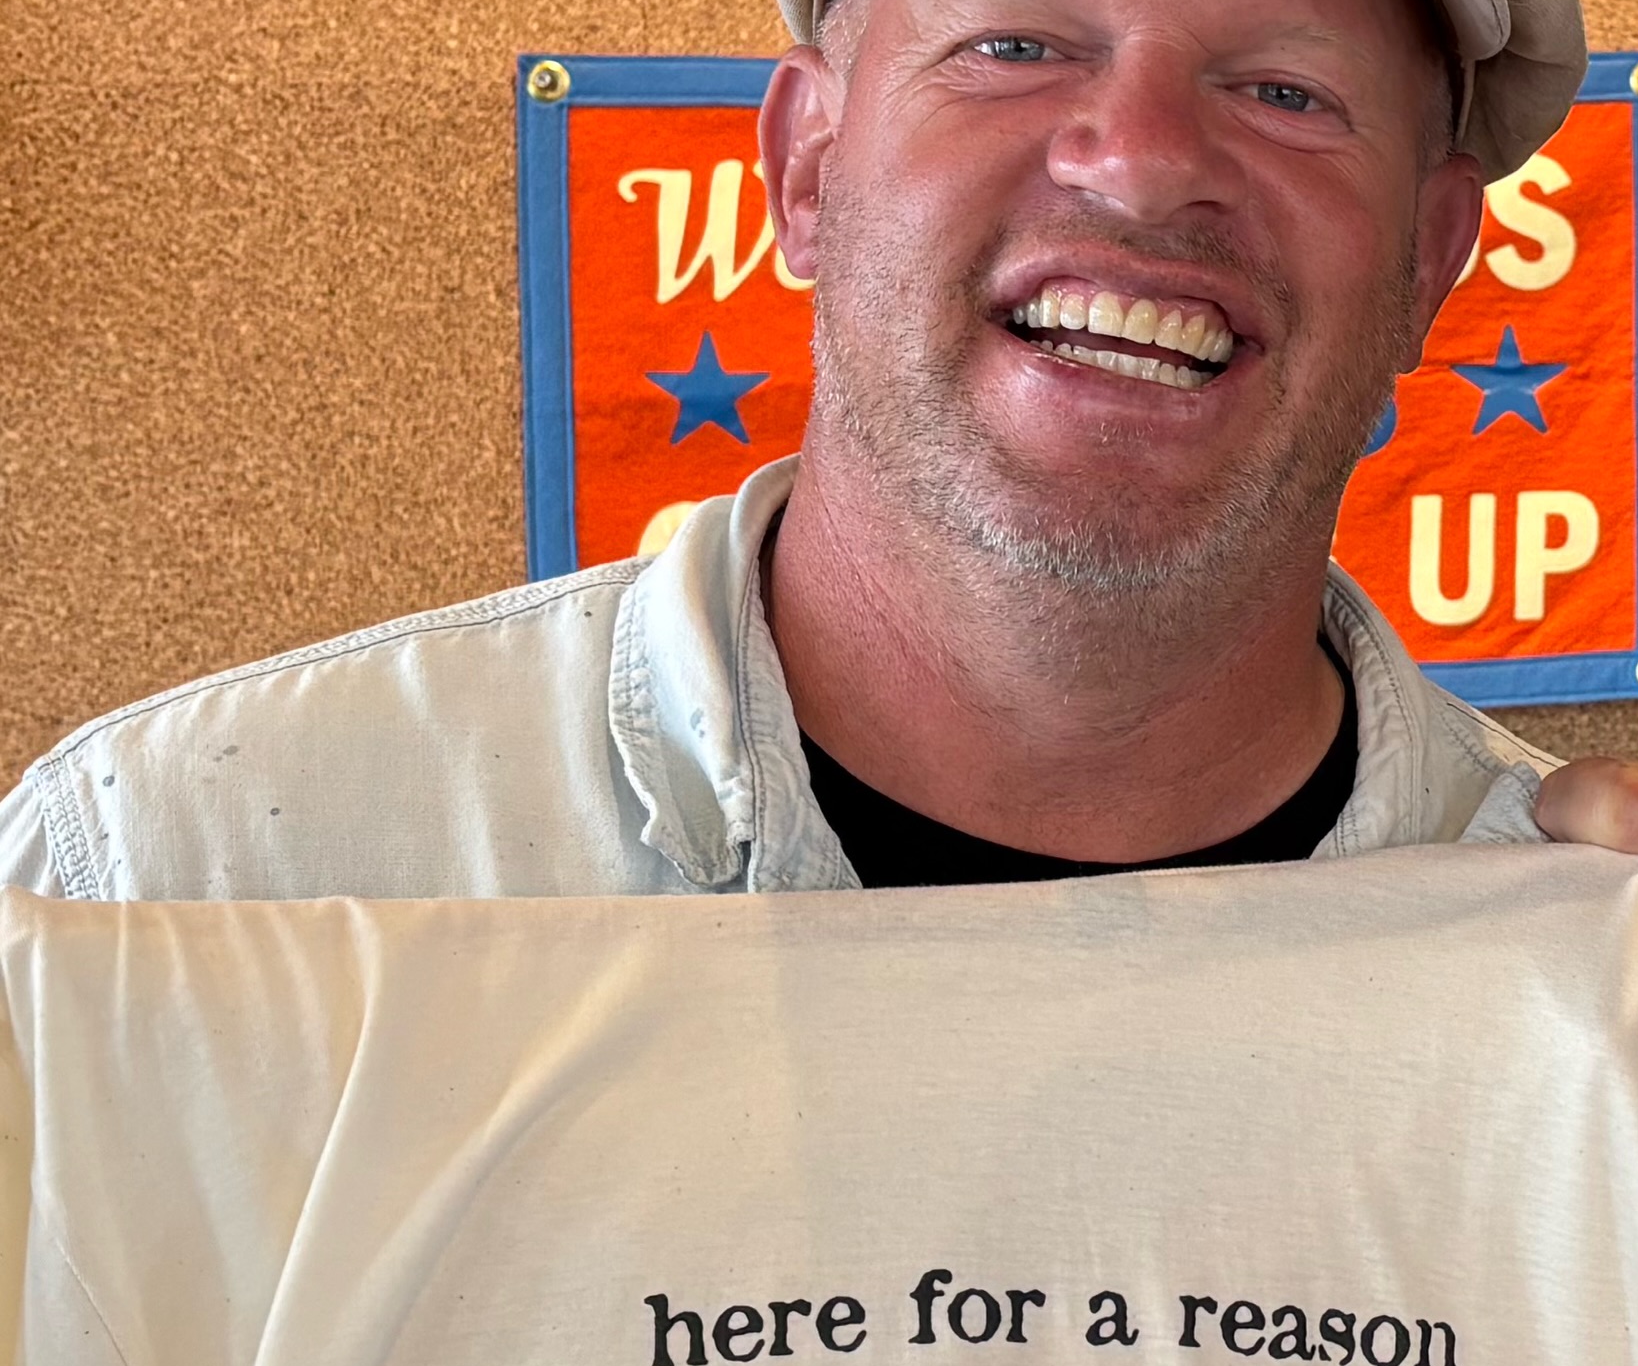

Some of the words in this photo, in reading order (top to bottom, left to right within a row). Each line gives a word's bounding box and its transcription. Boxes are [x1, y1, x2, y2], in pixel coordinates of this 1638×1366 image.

[1409, 490, 1600, 626] UP
[908, 1268, 1047, 1345] for
[1085, 1290, 1140, 1347] a
